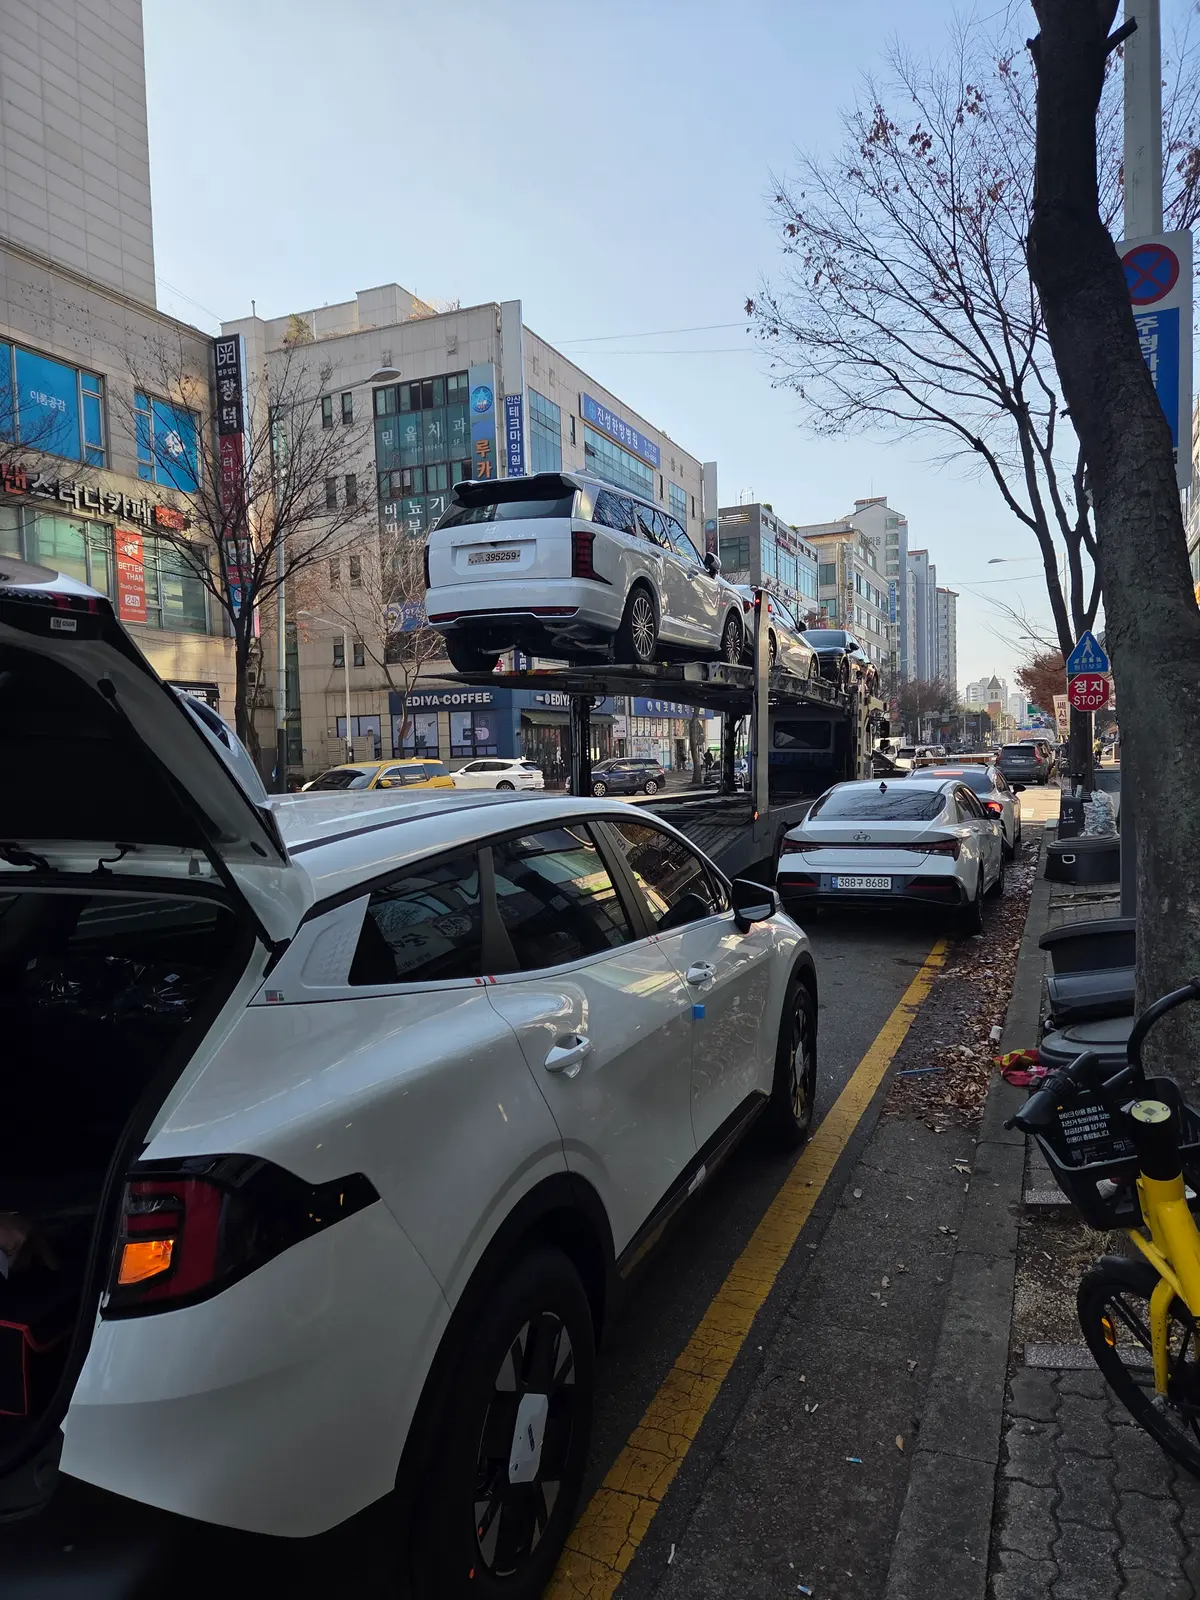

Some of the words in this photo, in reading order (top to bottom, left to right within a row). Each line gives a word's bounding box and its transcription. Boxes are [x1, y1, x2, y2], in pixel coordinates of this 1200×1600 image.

[220, 379, 237, 428] 광덕
[506, 395, 521, 405] 안산
[381, 417, 467, 446] 믿음치과
[597, 407, 638, 449] 진성한방병원
[509, 406, 521, 465] 테크마의원
[384, 496, 444, 519] 비뇨기
[485, 551, 516, 562] 395259
[118, 561, 144, 573] BETTER
[126, 572, 144, 582] THAN
[126, 595, 140, 606] 24h
[1074, 679, 1103, 694] 정지
[406, 695, 440, 707] EDIYA
[445, 692, 491, 705] COFFEE
[1073, 695, 1103, 706] STOP
[838, 877, 864, 888] 388구
[865, 878, 889, 888] 8688
